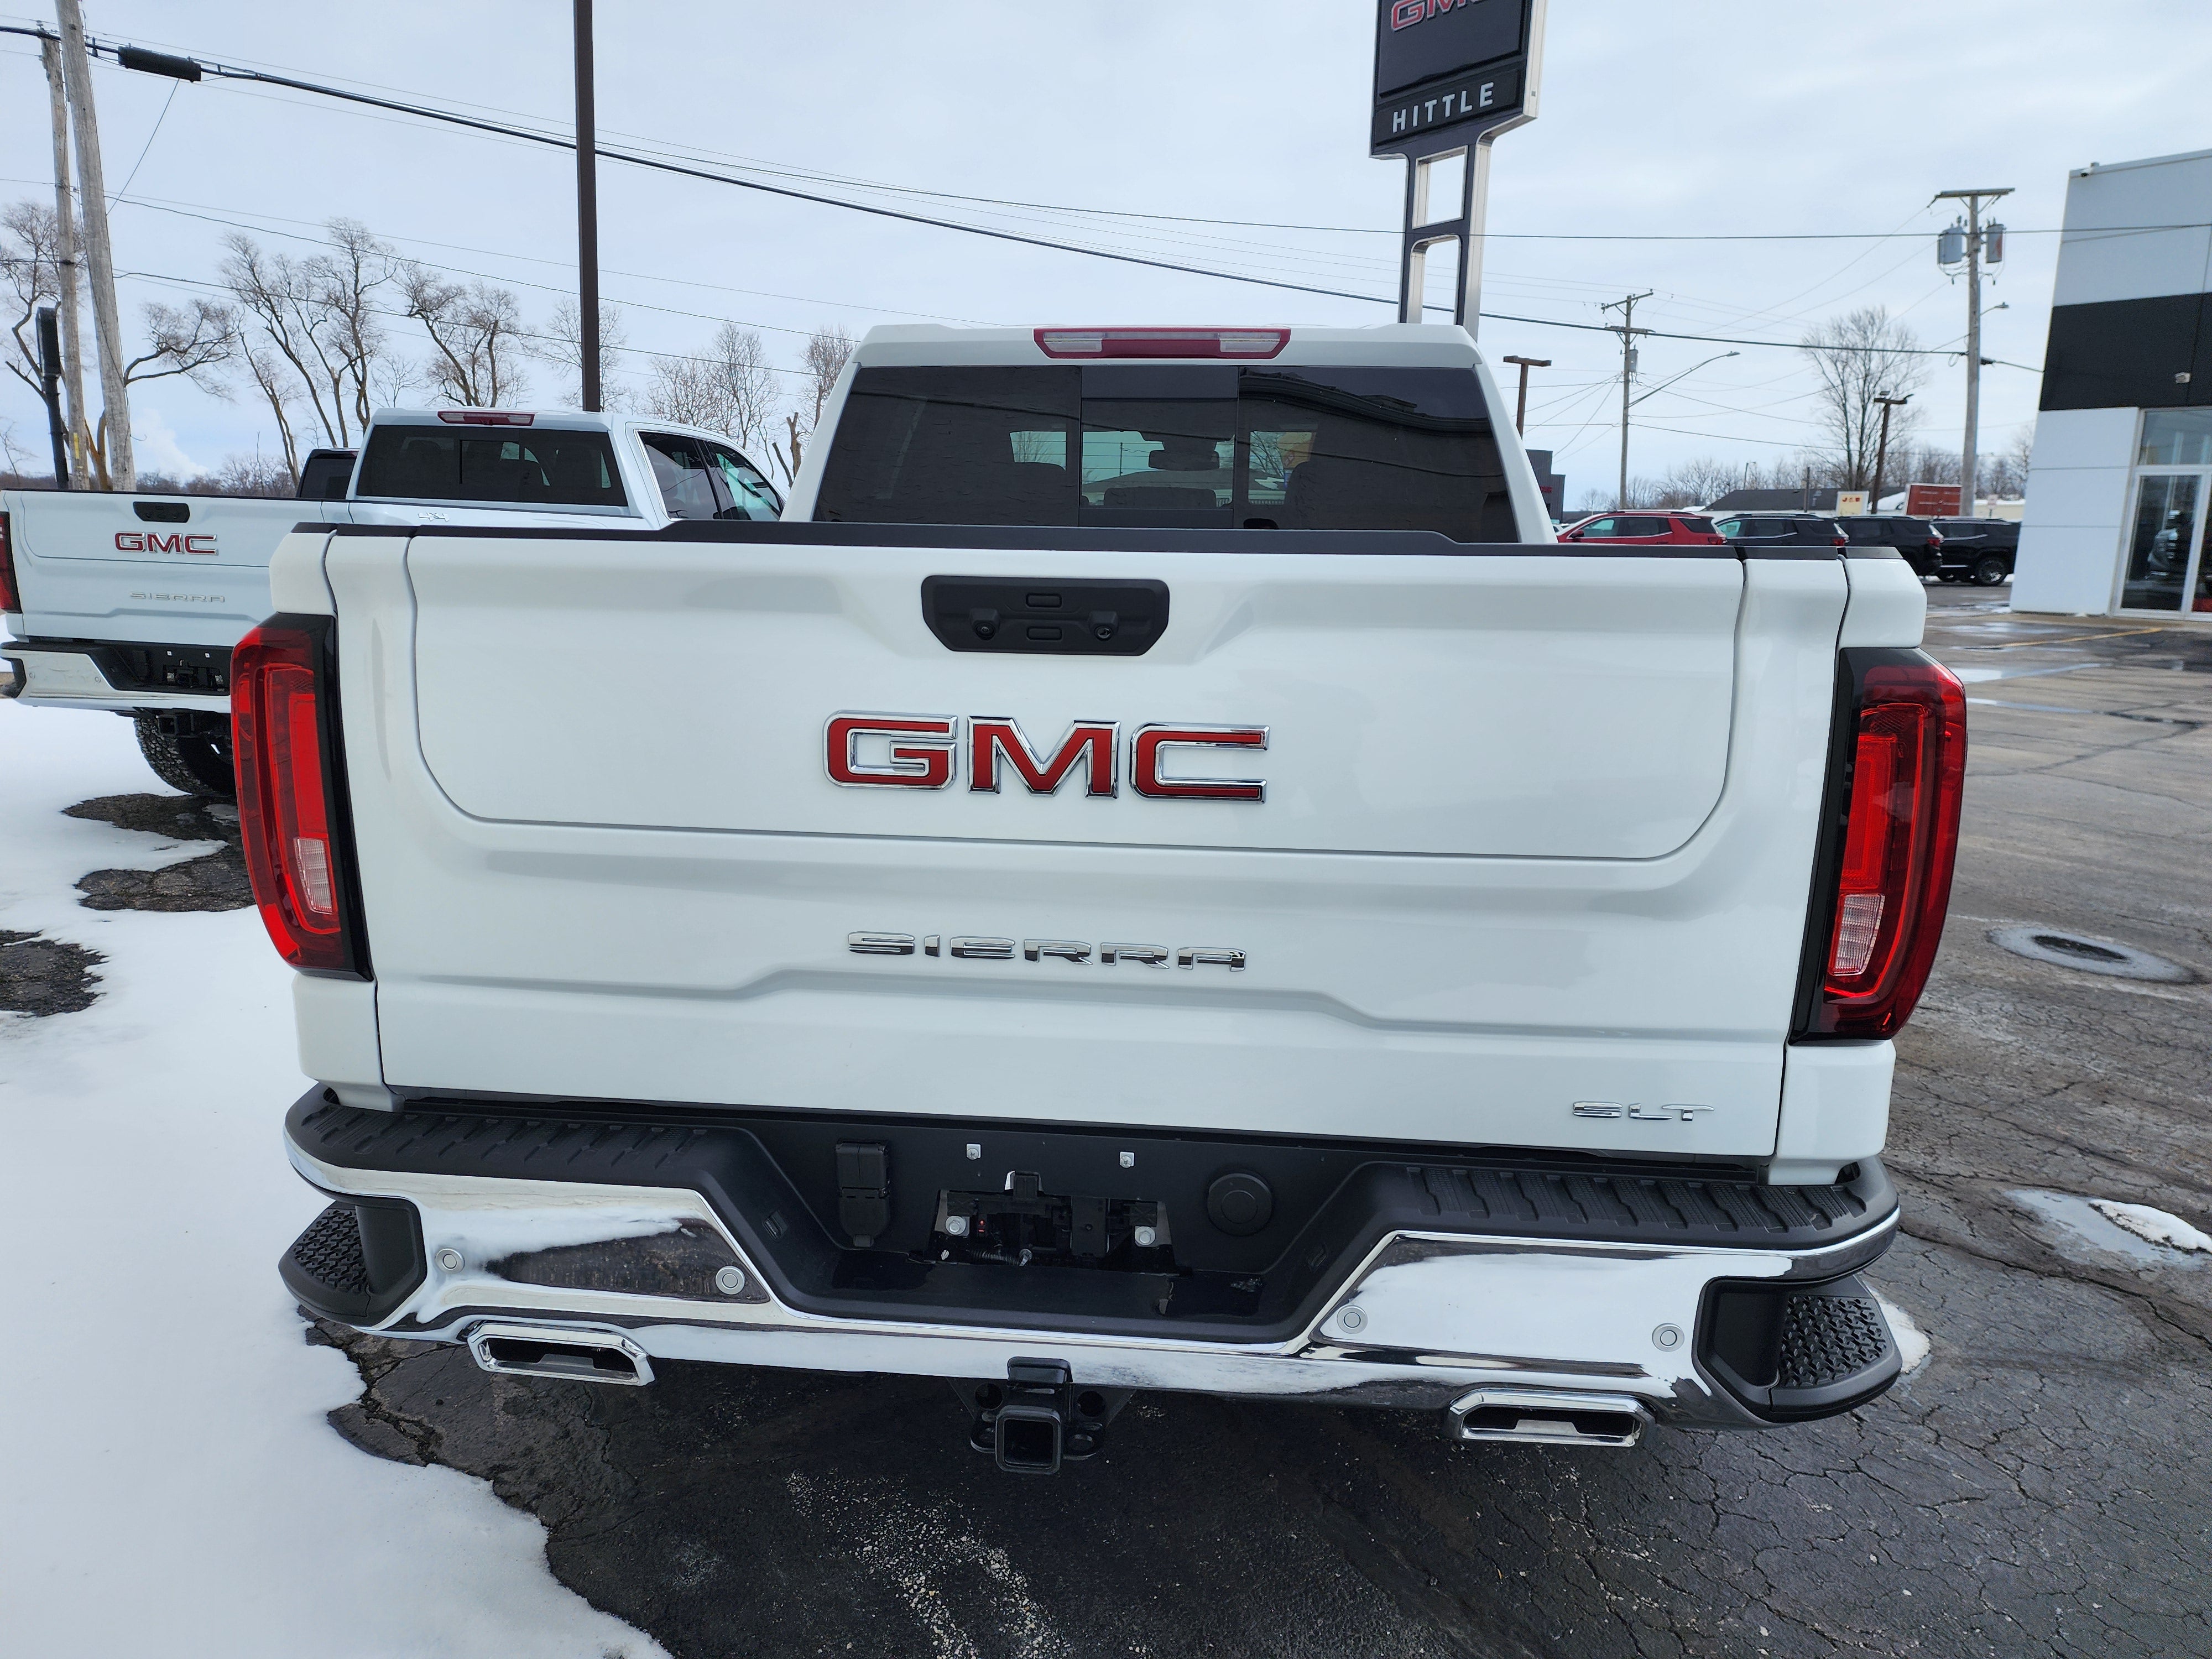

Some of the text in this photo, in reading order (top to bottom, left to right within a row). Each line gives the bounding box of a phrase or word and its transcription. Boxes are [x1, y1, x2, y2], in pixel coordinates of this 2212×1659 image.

[1392, 81, 1494, 132] HITTLE
[114, 531, 218, 556] GMC
[129, 591, 225, 603] SIERRA
[822, 709, 1270, 804] GMC
[848, 931, 1247, 972] SIERRA
[1572, 1100, 1714, 1121] SLT
